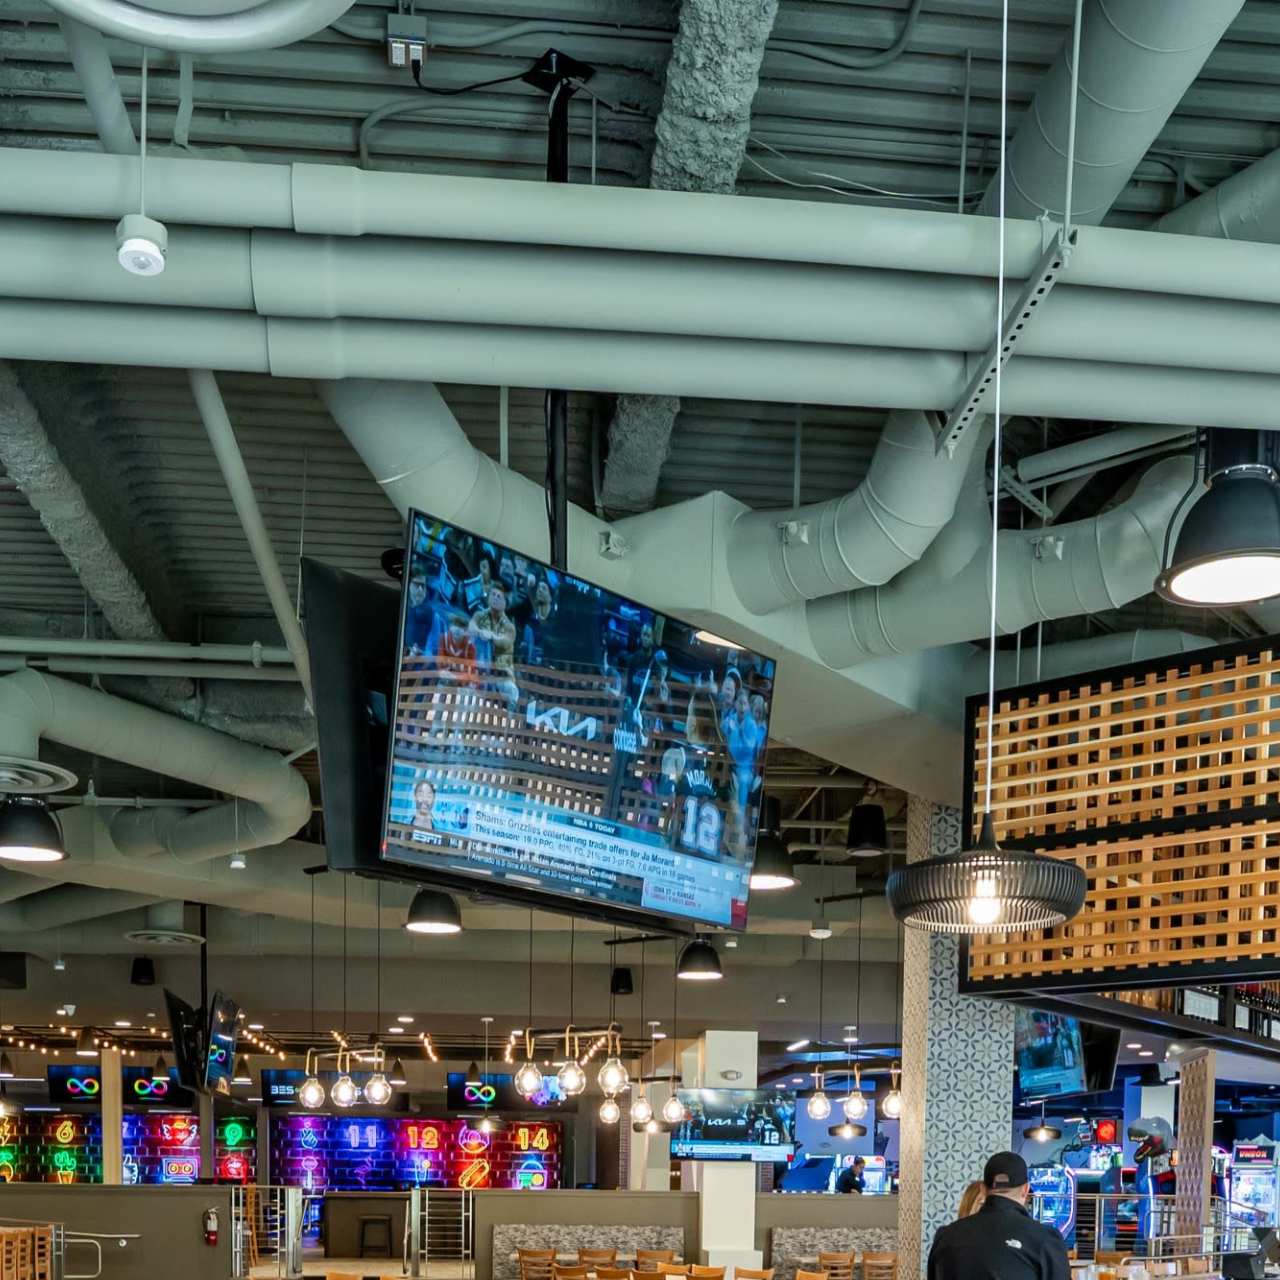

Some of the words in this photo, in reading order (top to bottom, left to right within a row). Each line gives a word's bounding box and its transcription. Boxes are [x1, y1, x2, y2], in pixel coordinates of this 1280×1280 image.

[527, 700, 596, 742] KIA
[475, 824, 490, 834] This
[595, 823, 616, 834] TODAY
[682, 795, 720, 855] 12
[476, 811, 506, 826] Shams:
[508, 819, 541, 836] Grizzlies
[543, 829, 587, 847] entertaining
[589, 839, 608, 850] trade
[609, 844, 630, 857] offers
[631, 848, 640, 858] for
[641, 852, 650, 861] Ja
[651, 854, 675, 866] Morant
[56, 1120, 74, 1144] 6
[225, 1123, 243, 1146] 9
[348, 1125, 377, 1148] 11
[407, 1126, 439, 1149] 12
[518, 1127, 550, 1151] 14
[764, 1130, 780, 1144] 12
